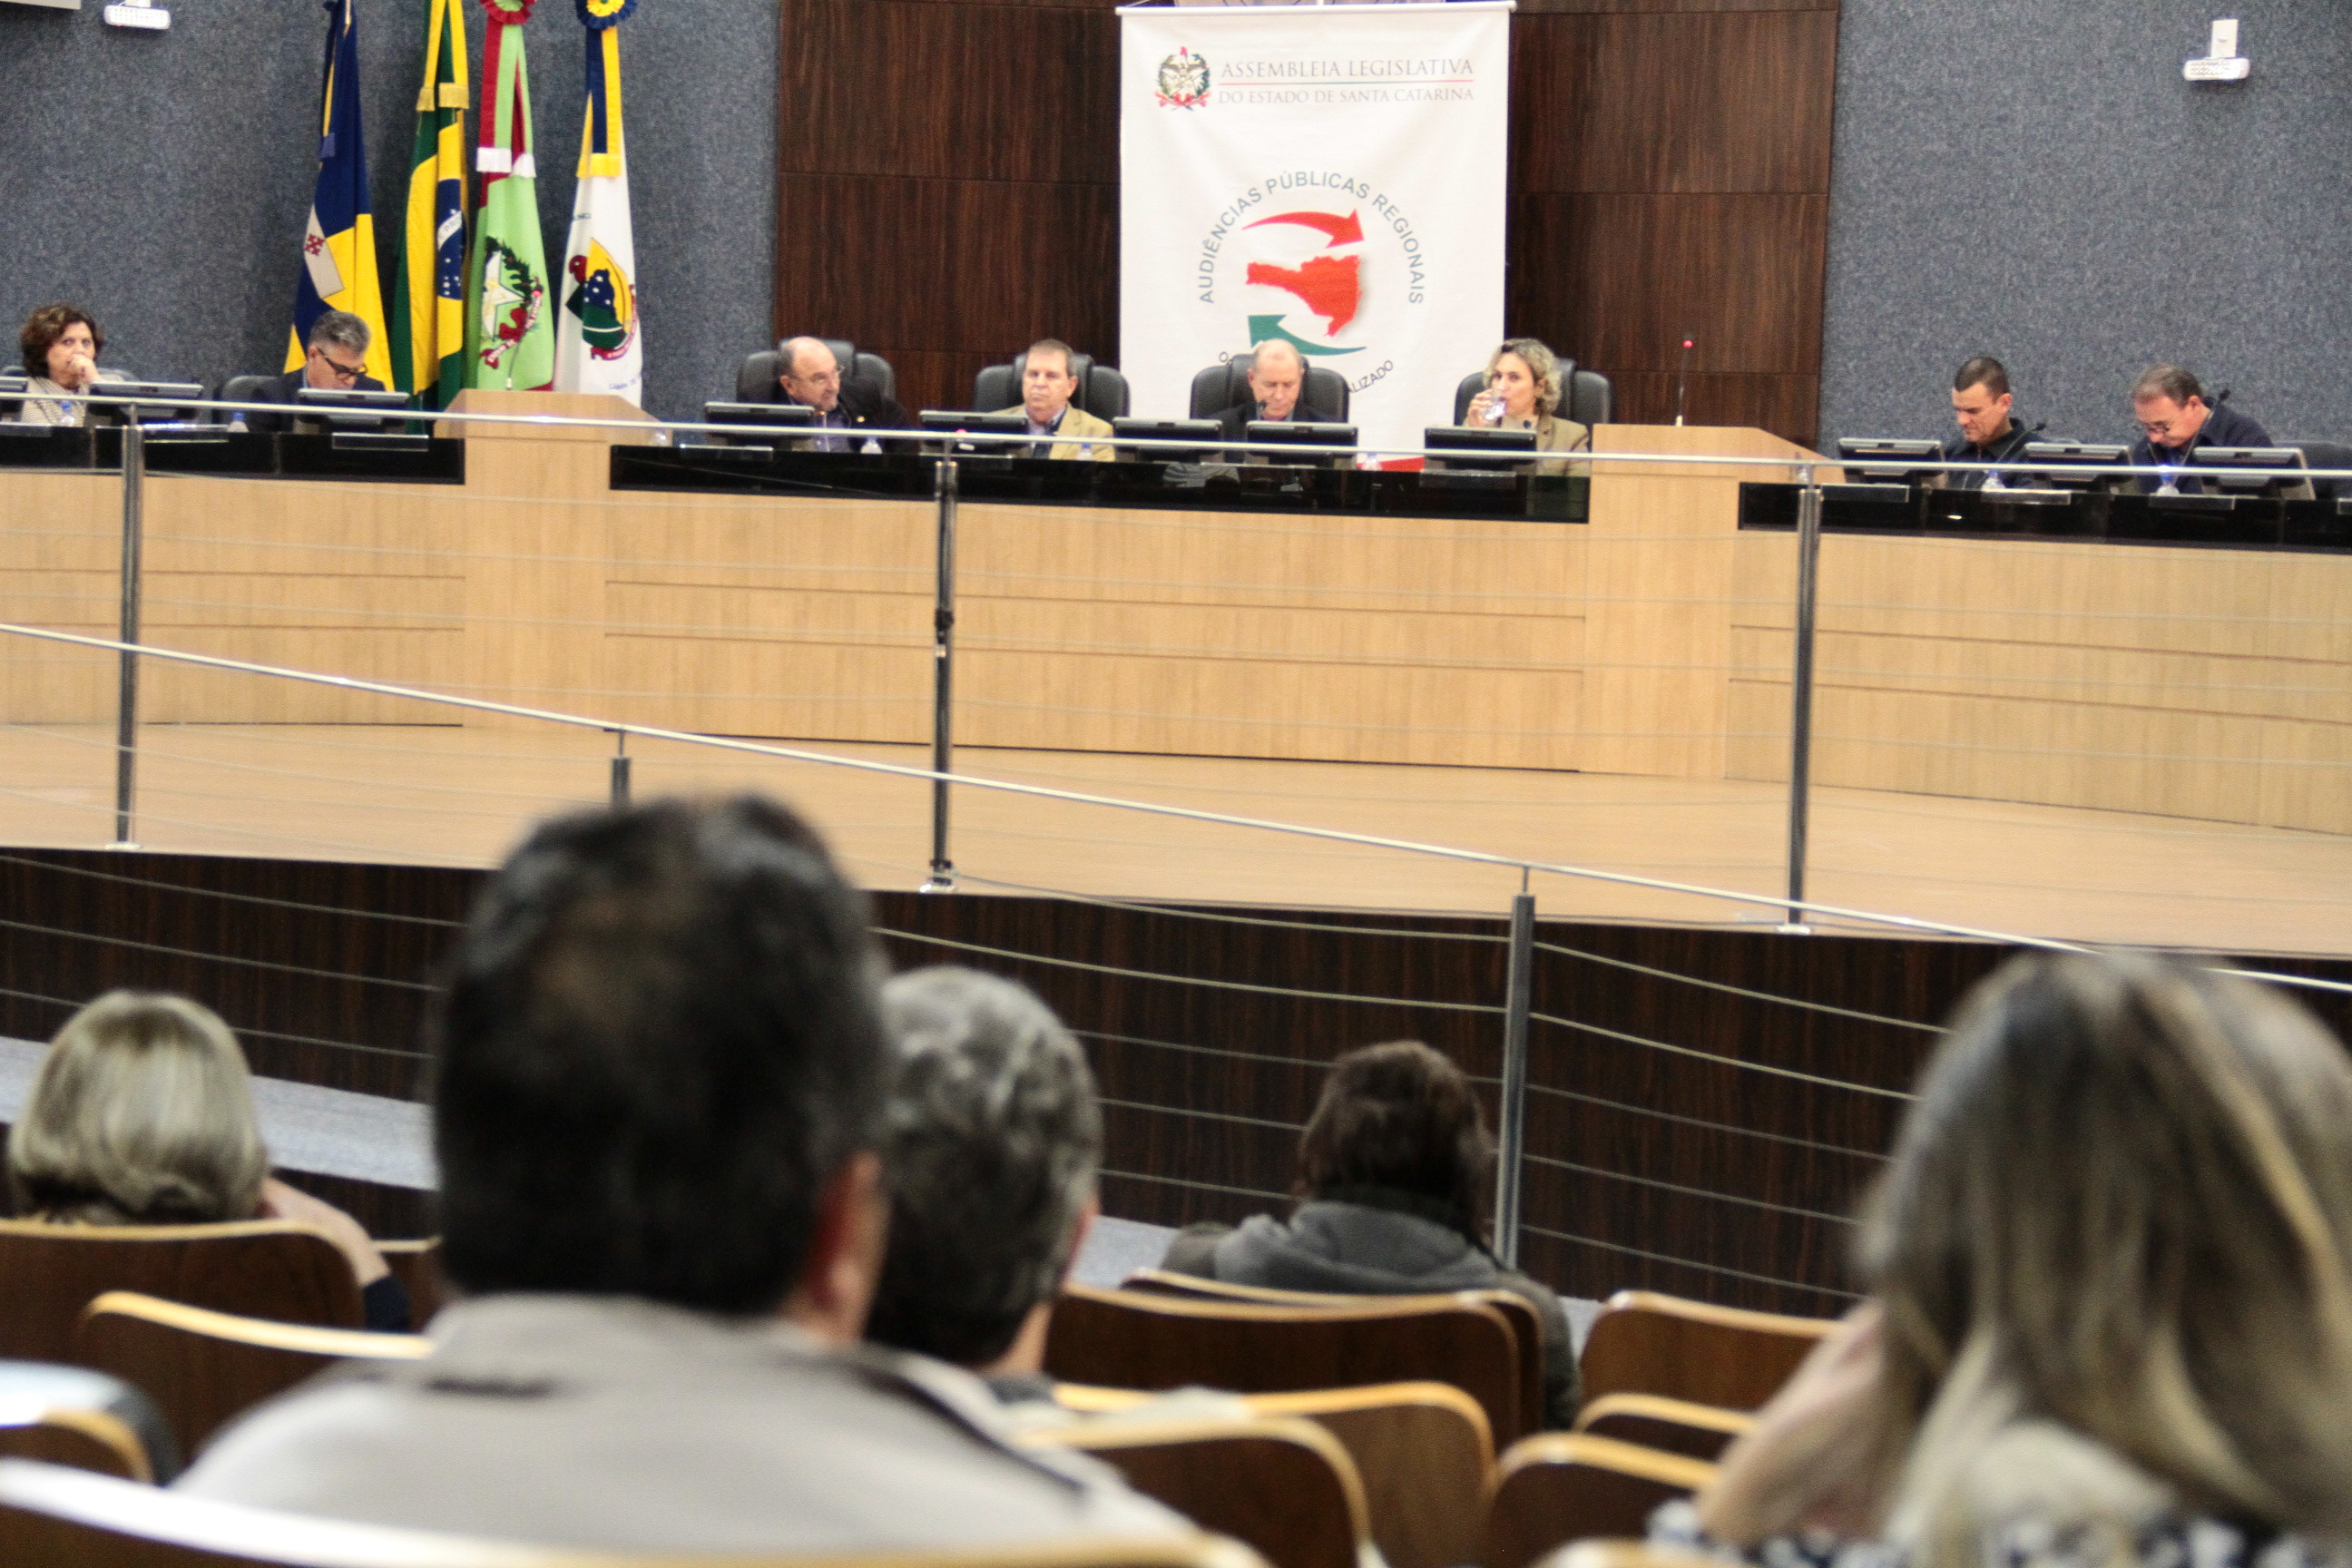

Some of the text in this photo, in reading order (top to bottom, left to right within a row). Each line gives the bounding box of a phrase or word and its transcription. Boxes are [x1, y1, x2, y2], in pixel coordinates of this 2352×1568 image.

[1221, 58, 1474, 78] ASSEMBLEIA LEGISLATIVA
[1220, 88, 1474, 104] DO ESTADO DE SANTA CATARINA
[1198, 170, 1425, 304] AUDIÊNCIAS PÚBLICAS REGIONAIS
[1348, 359, 1394, 393] LIZADO
